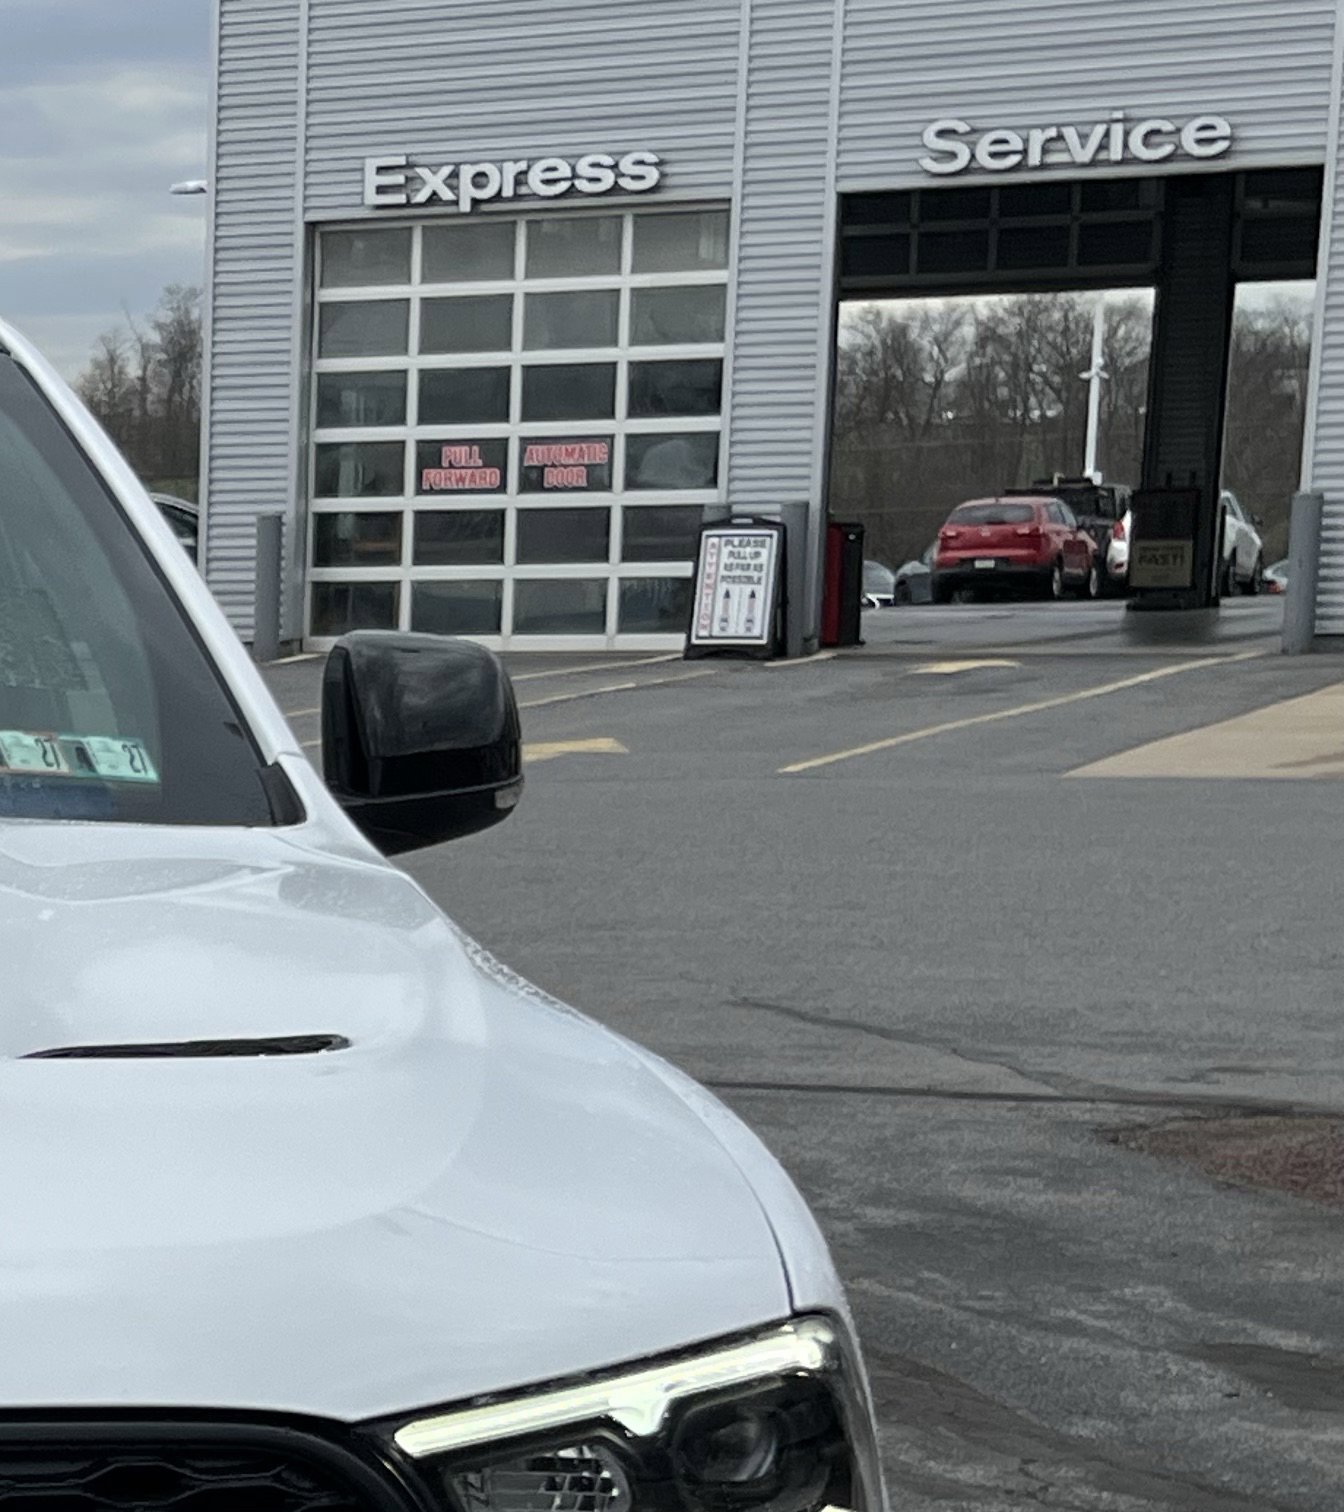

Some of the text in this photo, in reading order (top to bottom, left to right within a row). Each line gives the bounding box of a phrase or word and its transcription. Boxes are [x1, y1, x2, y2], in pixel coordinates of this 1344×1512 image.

[918, 101, 1231, 175] Service
[363, 151, 661, 213] Express
[442, 446, 483, 467] PULL
[524, 443, 609, 466] AUTOMATIC
[422, 469, 501, 490] FORWARD
[543, 466, 587, 488] DOOR
[724, 538, 766, 549] PLEASE
